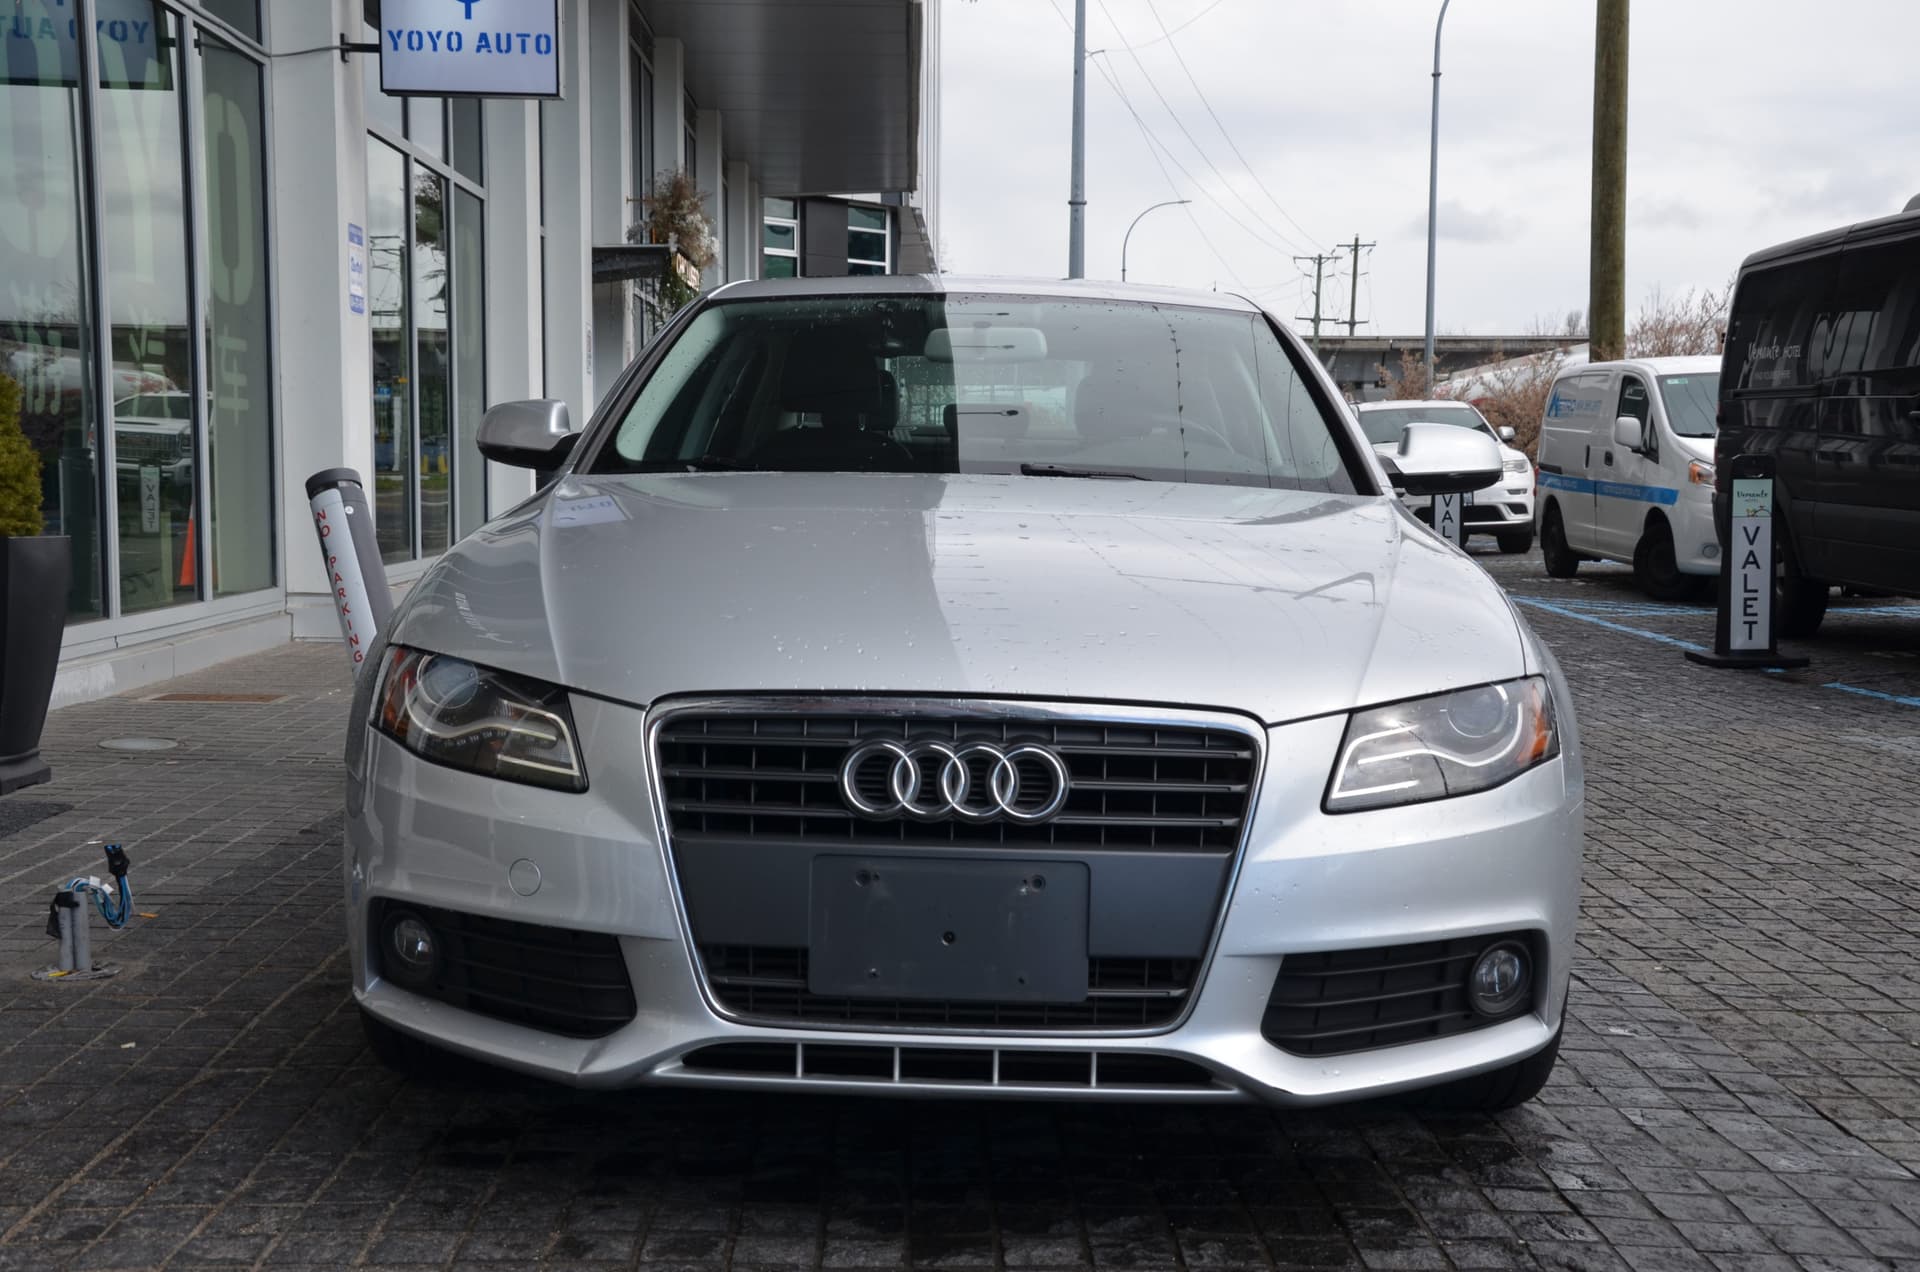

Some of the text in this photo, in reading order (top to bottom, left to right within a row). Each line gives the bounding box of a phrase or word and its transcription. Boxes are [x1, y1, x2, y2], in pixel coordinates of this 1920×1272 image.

[387, 29, 552, 55] YOYO AUTO
[316, 509, 364, 663] NO PARKING
[1741, 525, 1761, 641] VALET
